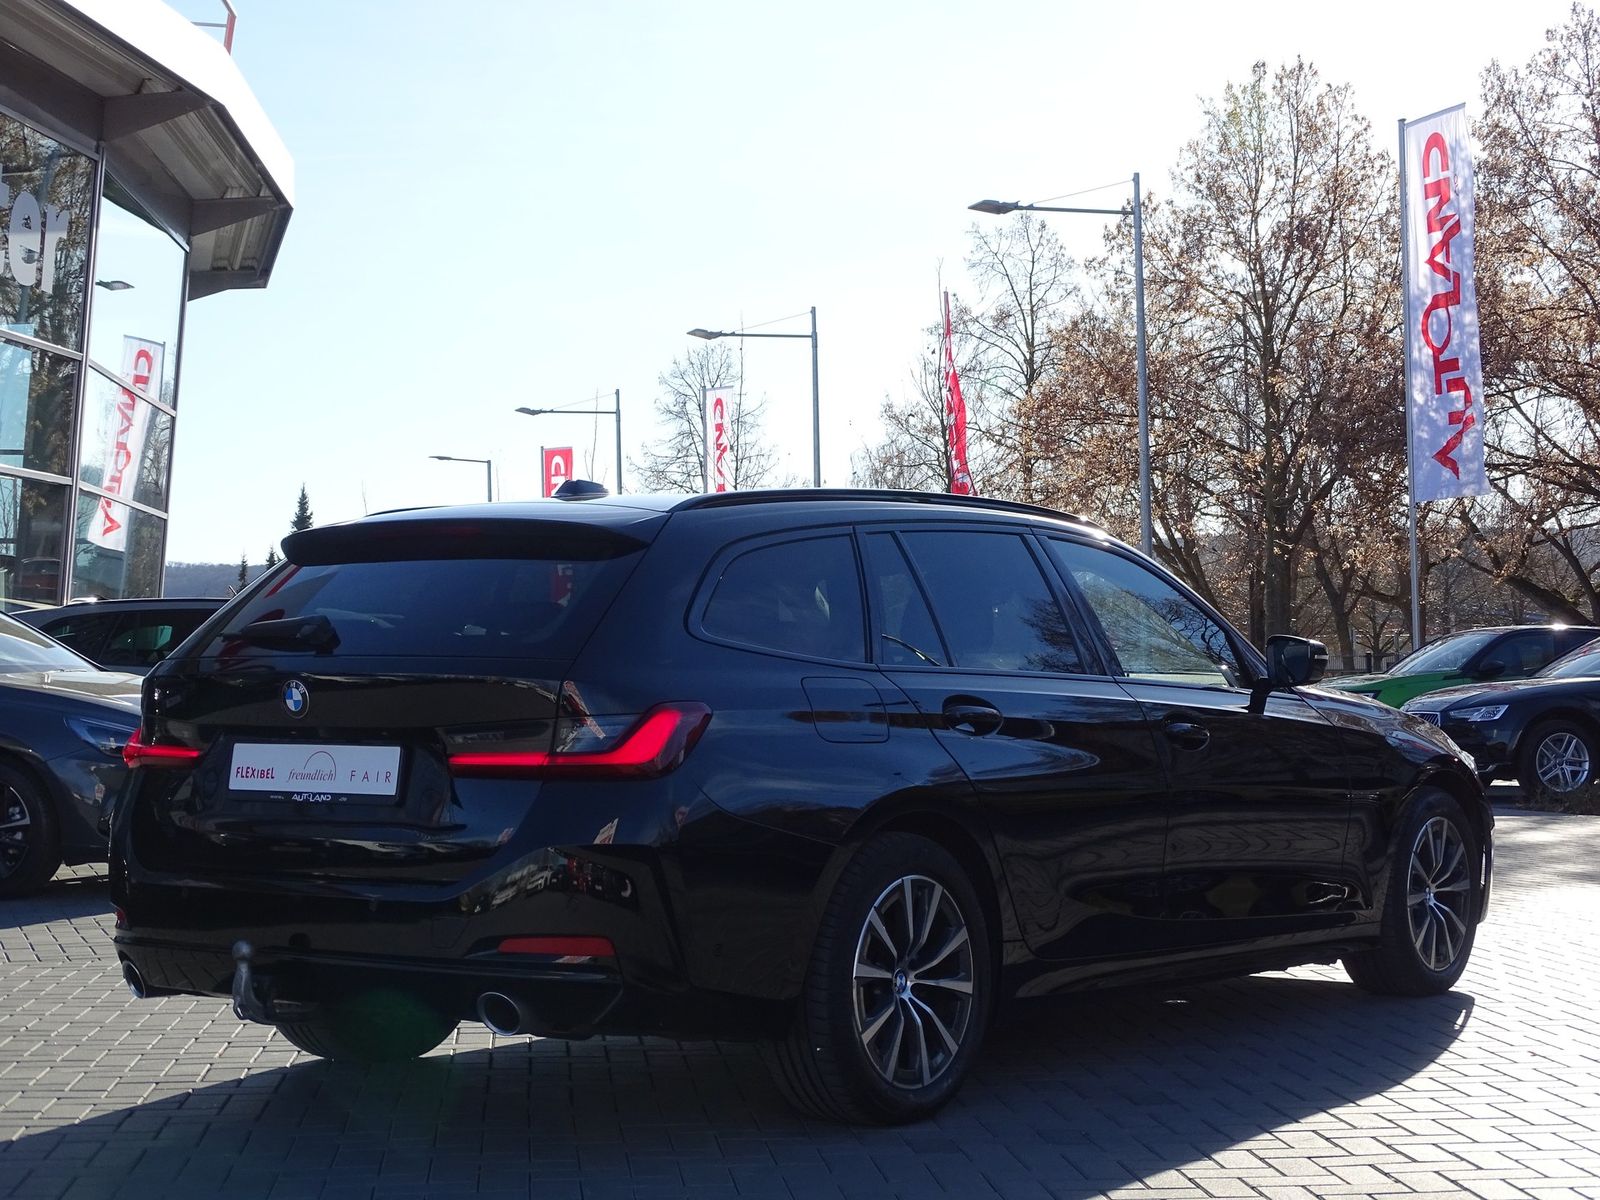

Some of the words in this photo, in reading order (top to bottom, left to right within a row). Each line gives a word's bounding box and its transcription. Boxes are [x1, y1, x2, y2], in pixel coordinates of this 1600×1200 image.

[1421, 131, 1476, 481] AUTOLAND
[235, 766, 275, 780] FLEXIBEL
[287, 768, 334, 783] freundlich
[350, 769, 392, 784] FAIR
[291, 793, 332, 802] AUTOLAND
